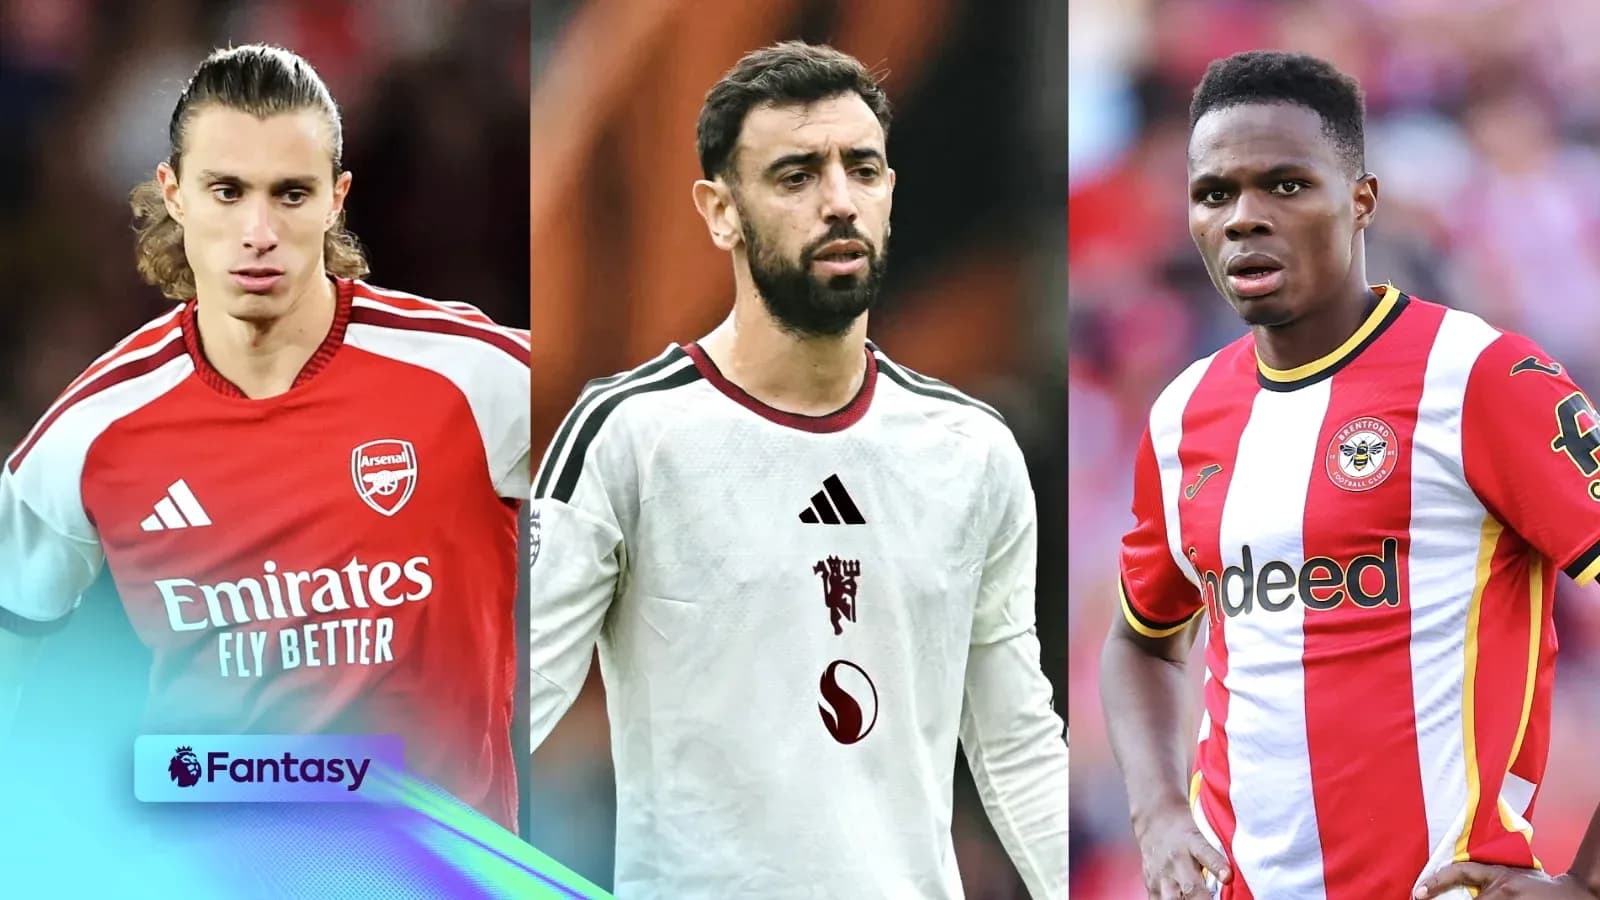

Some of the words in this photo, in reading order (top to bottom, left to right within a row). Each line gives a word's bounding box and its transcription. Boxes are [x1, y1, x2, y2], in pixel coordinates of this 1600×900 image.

[1338, 421, 1389, 441] BRENTFORD
[361, 451, 406, 467] Arsenal
[1333, 471, 1367, 487] FOOTBALL
[1368, 469, 1387, 484] CLUB
[154, 556, 432, 632] Emirates
[218, 631, 267, 677] FLY
[280, 617, 394, 670] BETTER
